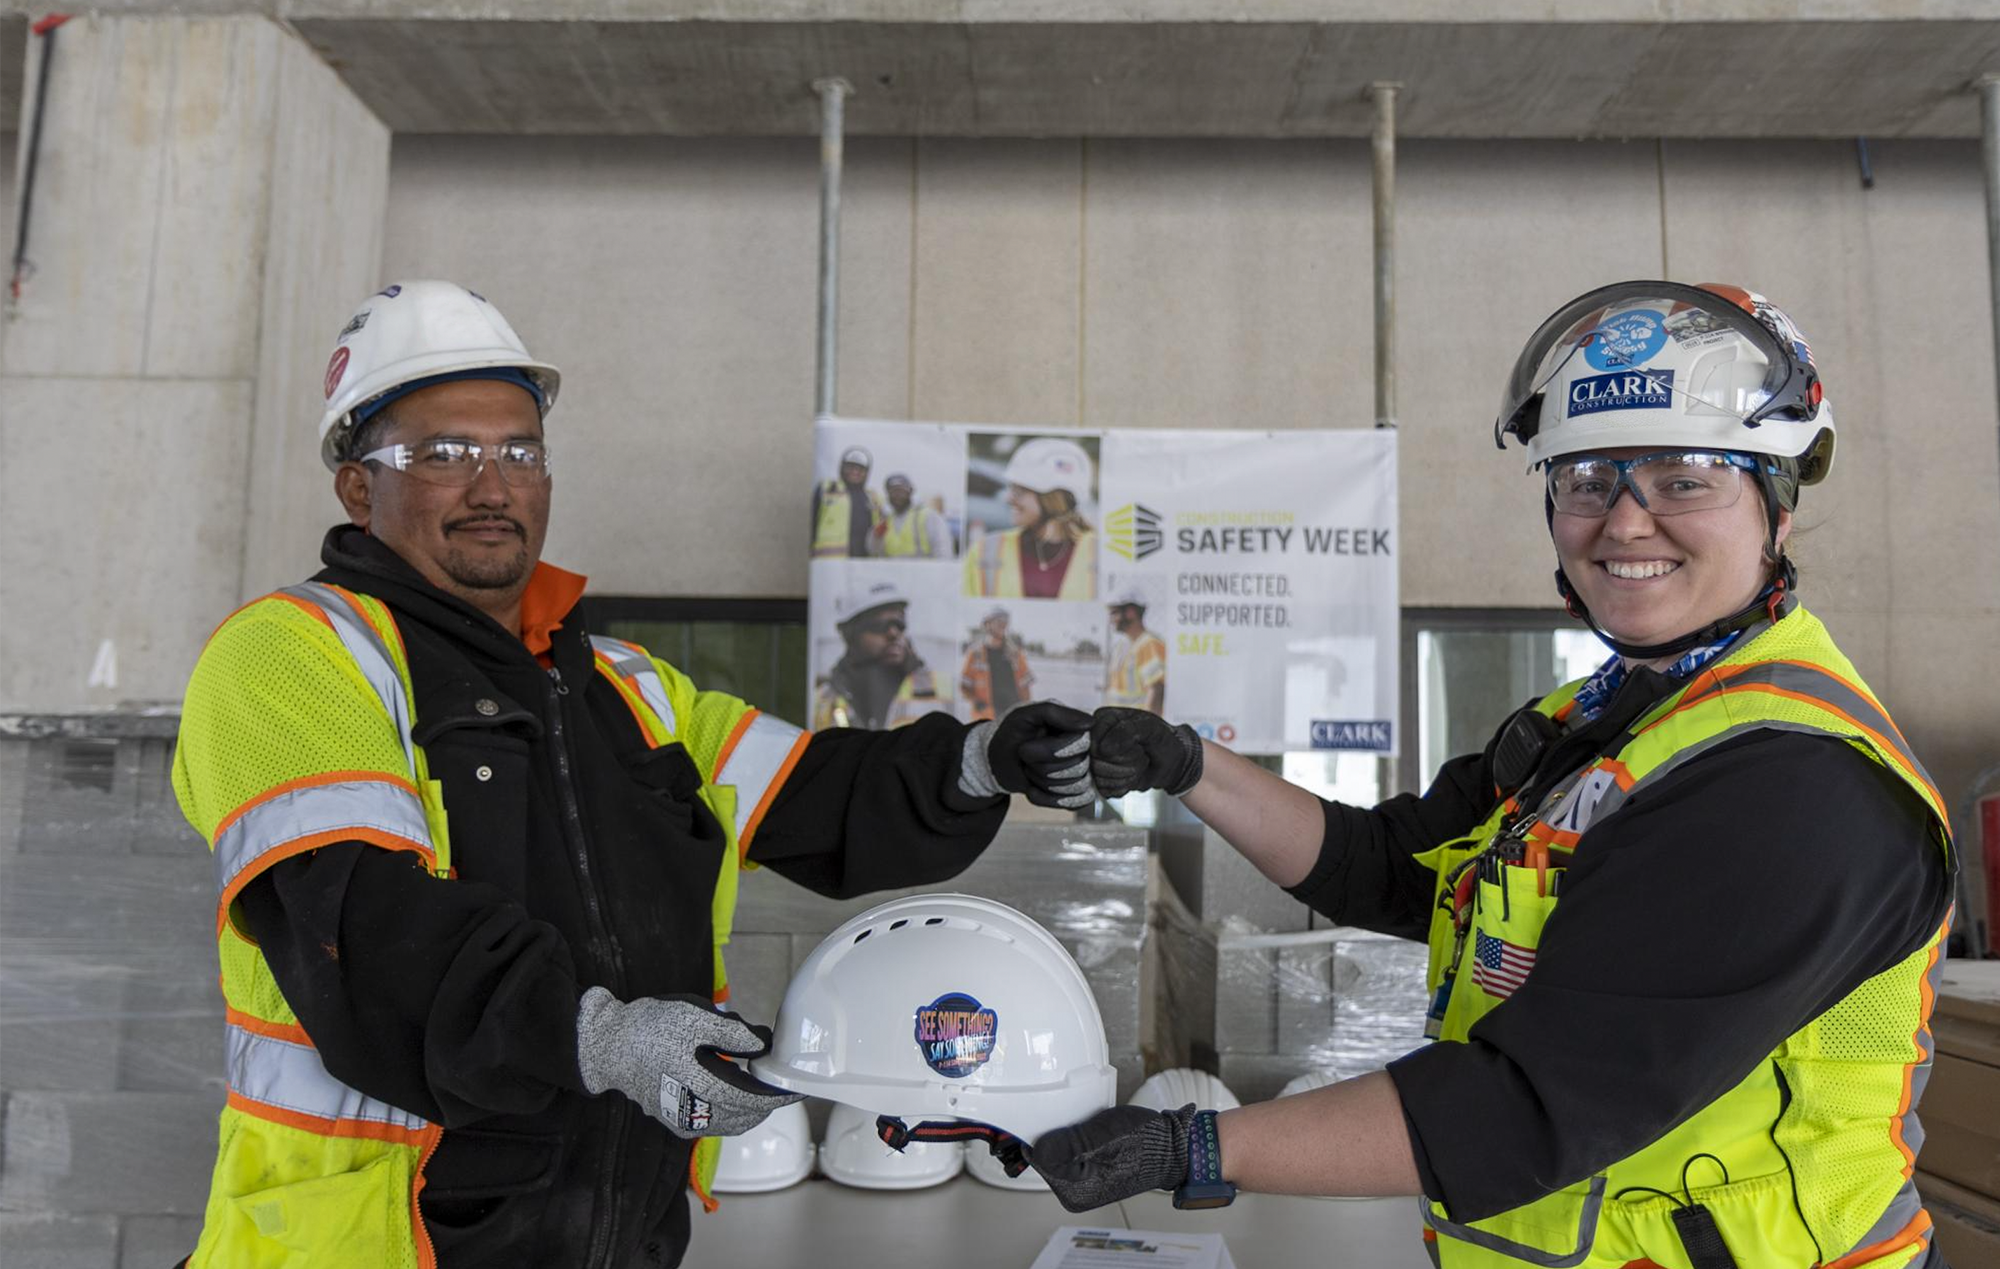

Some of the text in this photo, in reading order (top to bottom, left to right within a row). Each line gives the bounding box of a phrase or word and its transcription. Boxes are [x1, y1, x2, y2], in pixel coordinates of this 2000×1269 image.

[1572, 375, 1667, 403] CLARK
[1570, 395, 1668, 412] CONSTRUCTION
[1174, 511, 1295, 526] CONSTRUCTION
[1176, 527, 1391, 555] SAFETY WEEK
[1177, 572, 1293, 597] CONNECTED.
[1176, 604, 1292, 627] SUPPORTED.
[1177, 634, 1229, 655] SAFE.
[1311, 722, 1389, 744] CLARK
[919, 1010, 994, 1041] SEE SOMETHING?
[930, 1041, 945, 1062] SAY
